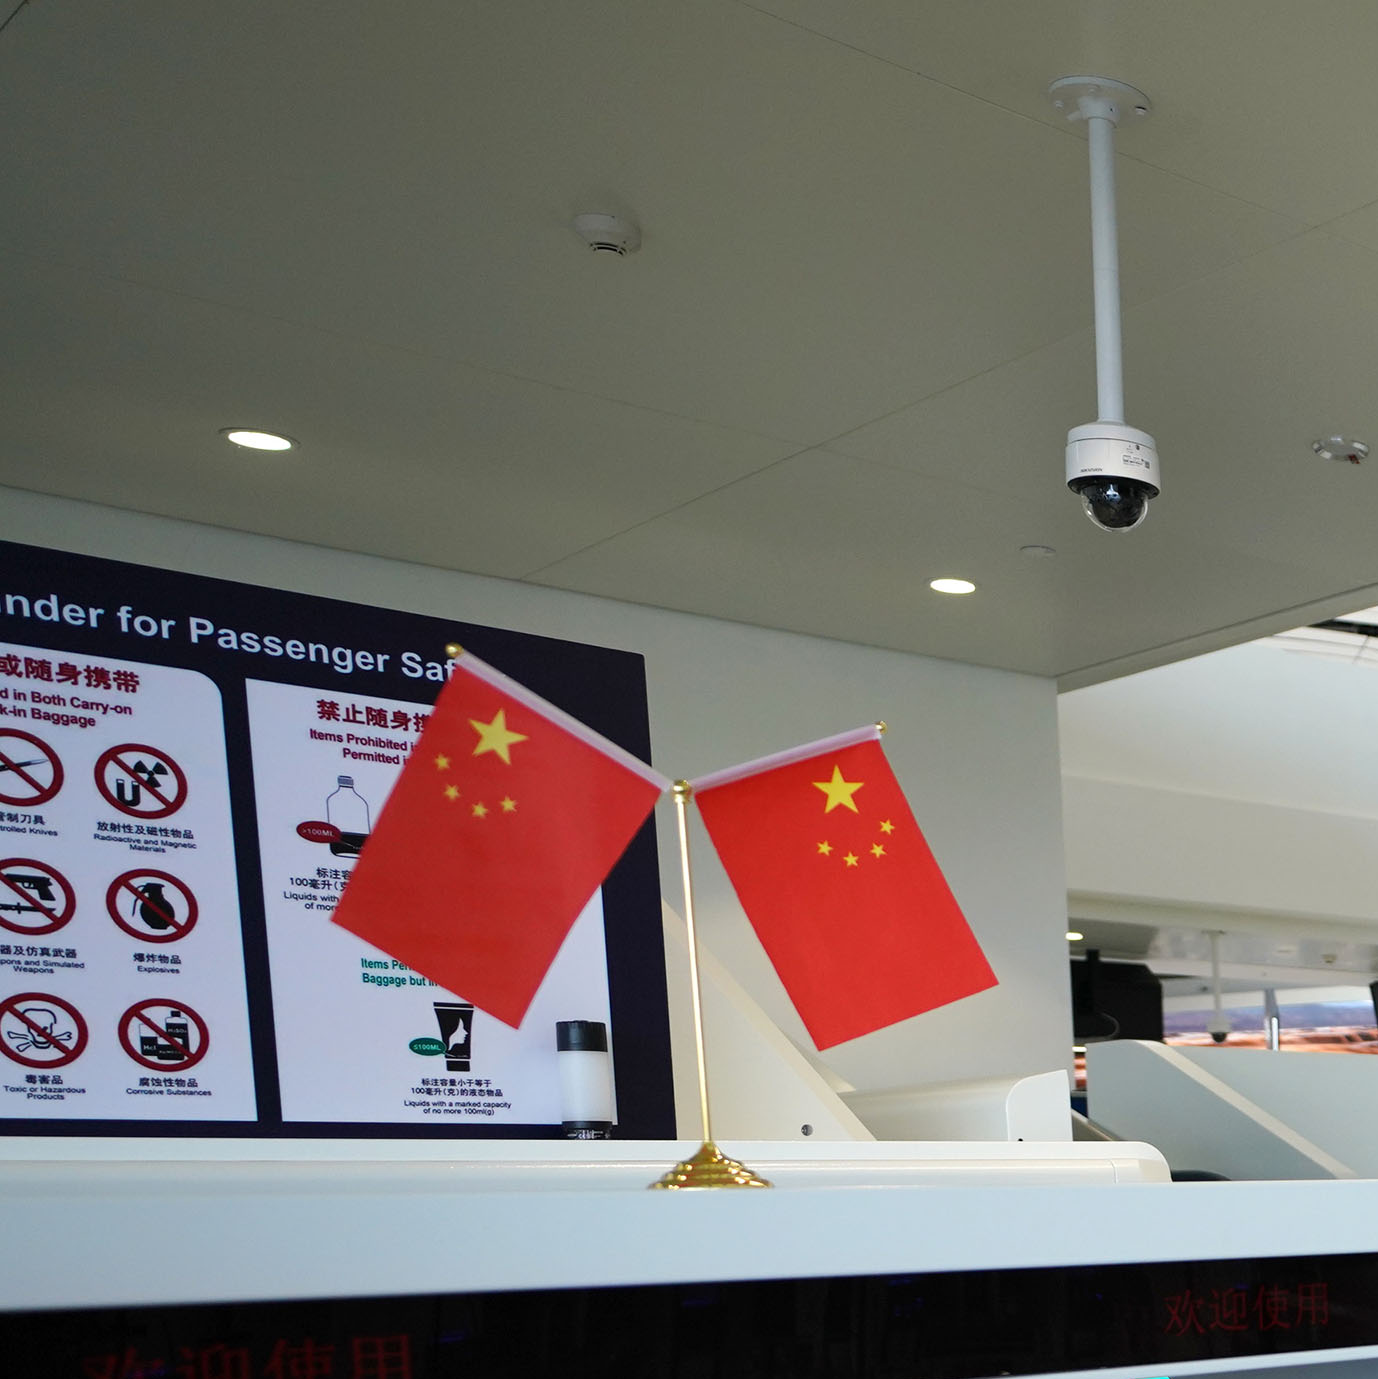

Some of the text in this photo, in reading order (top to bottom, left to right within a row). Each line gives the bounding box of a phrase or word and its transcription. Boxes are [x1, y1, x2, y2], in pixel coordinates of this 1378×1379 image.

[0, 594, 105, 629] nder
[116, 605, 177, 640] for
[188, 616, 391, 674] Passenger
[13, 689, 27, 702] in
[30, 690, 67, 708] Both
[70, 696, 133, 716] Carry-on
[31, 708, 97, 729] Baggage
[309, 728, 408, 752] Items Prohibited
[342, 747, 401, 765] Permitted
[0, 824, 198, 850] trolled Knives Radioactive and Magnetic
[96, 820, 196, 840] 放射性及磁性物品
[129, 843, 167, 854] Materials
[316, 866, 353, 880] 标注容
[283, 890, 341, 903] Liquids with
[304, 901, 338, 912] of mor
[132, 952, 183, 966] 爆炸物品
[361, 957, 389, 970] Items
[13, 964, 55, 975] Weapons
[24, 958, 181, 975] and Simulated Explosives
[362, 972, 426, 988] Baggage but
[138, 1076, 199, 1088] 腐蚀性物品
[421, 1077, 493, 1088] 标注容量小于等于
[3, 1084, 213, 1097] Toxic or Hazardous Corrosive Substances
[26, 1092, 65, 1101] Products
[404, 1099, 431, 1109] Liquids
[431, 1100, 447, 1108] with
[454, 1101, 482, 1109] marked
[482, 1101, 512, 1111] capacity
[423, 1107, 431, 1115] of
[1163, 1281, 1330, 1338] 欢迎使用
